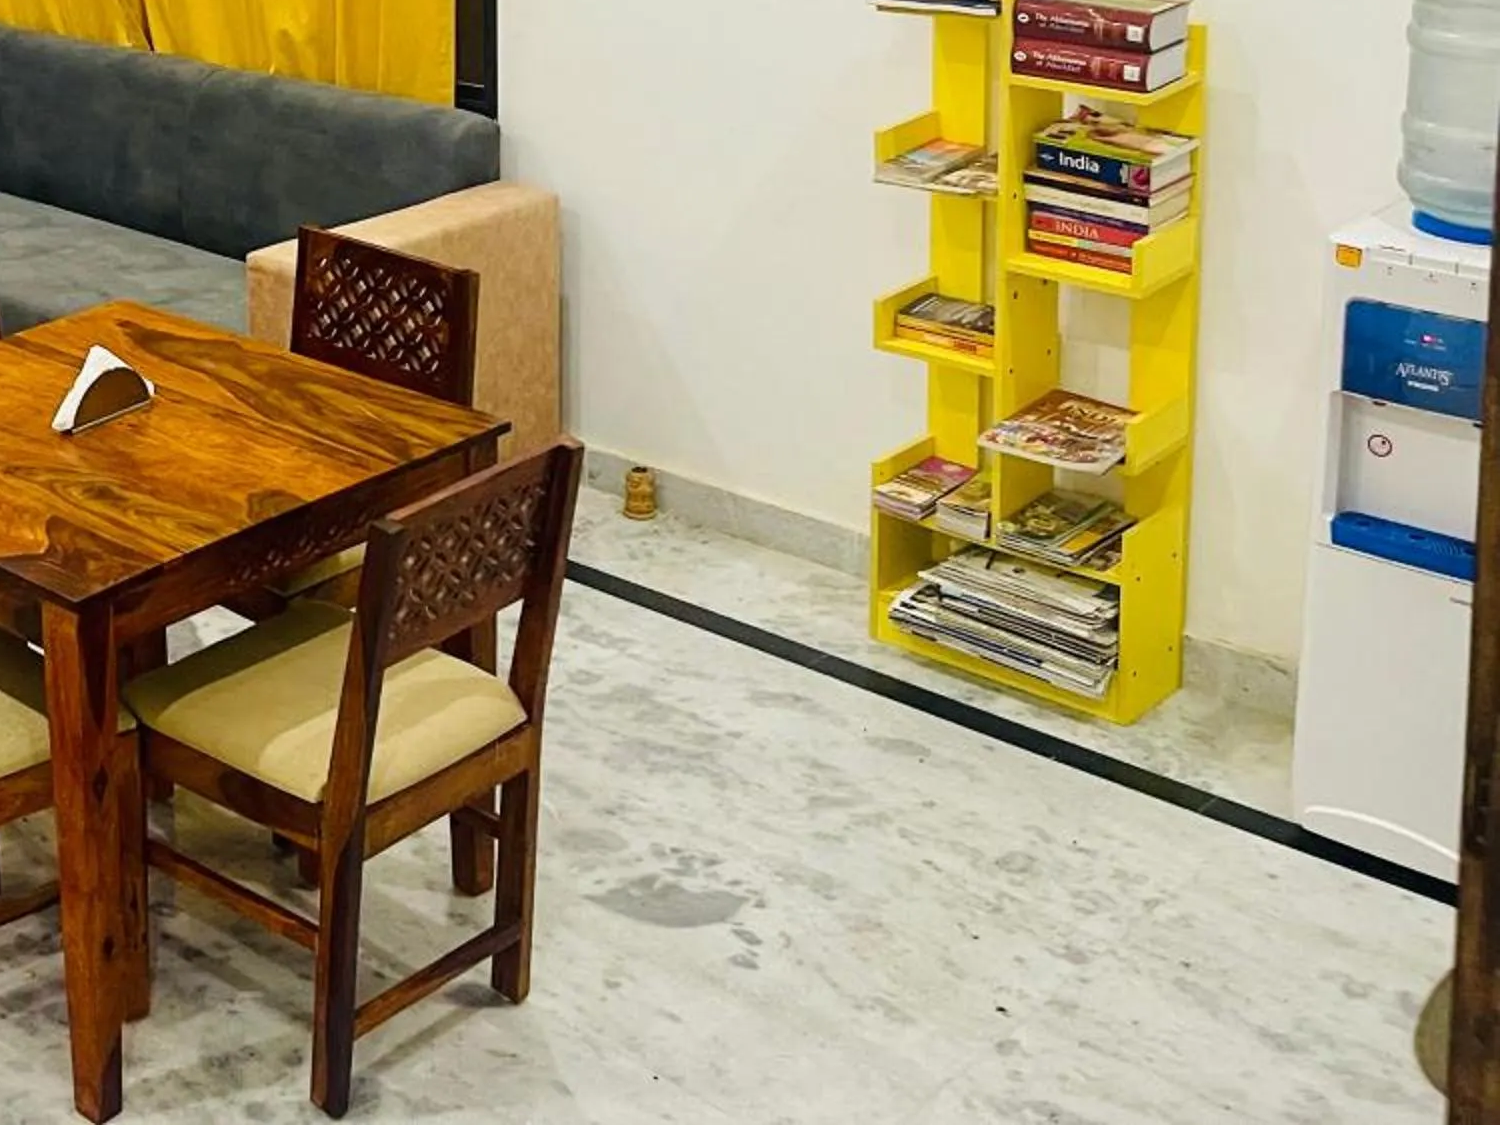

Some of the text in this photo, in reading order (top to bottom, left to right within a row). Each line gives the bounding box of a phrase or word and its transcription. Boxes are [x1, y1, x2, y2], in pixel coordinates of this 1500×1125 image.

[1058, 151, 1100, 174] India
[1055, 220, 1100, 239] INDIA
[1395, 363, 1452, 386] ATLANTIS
